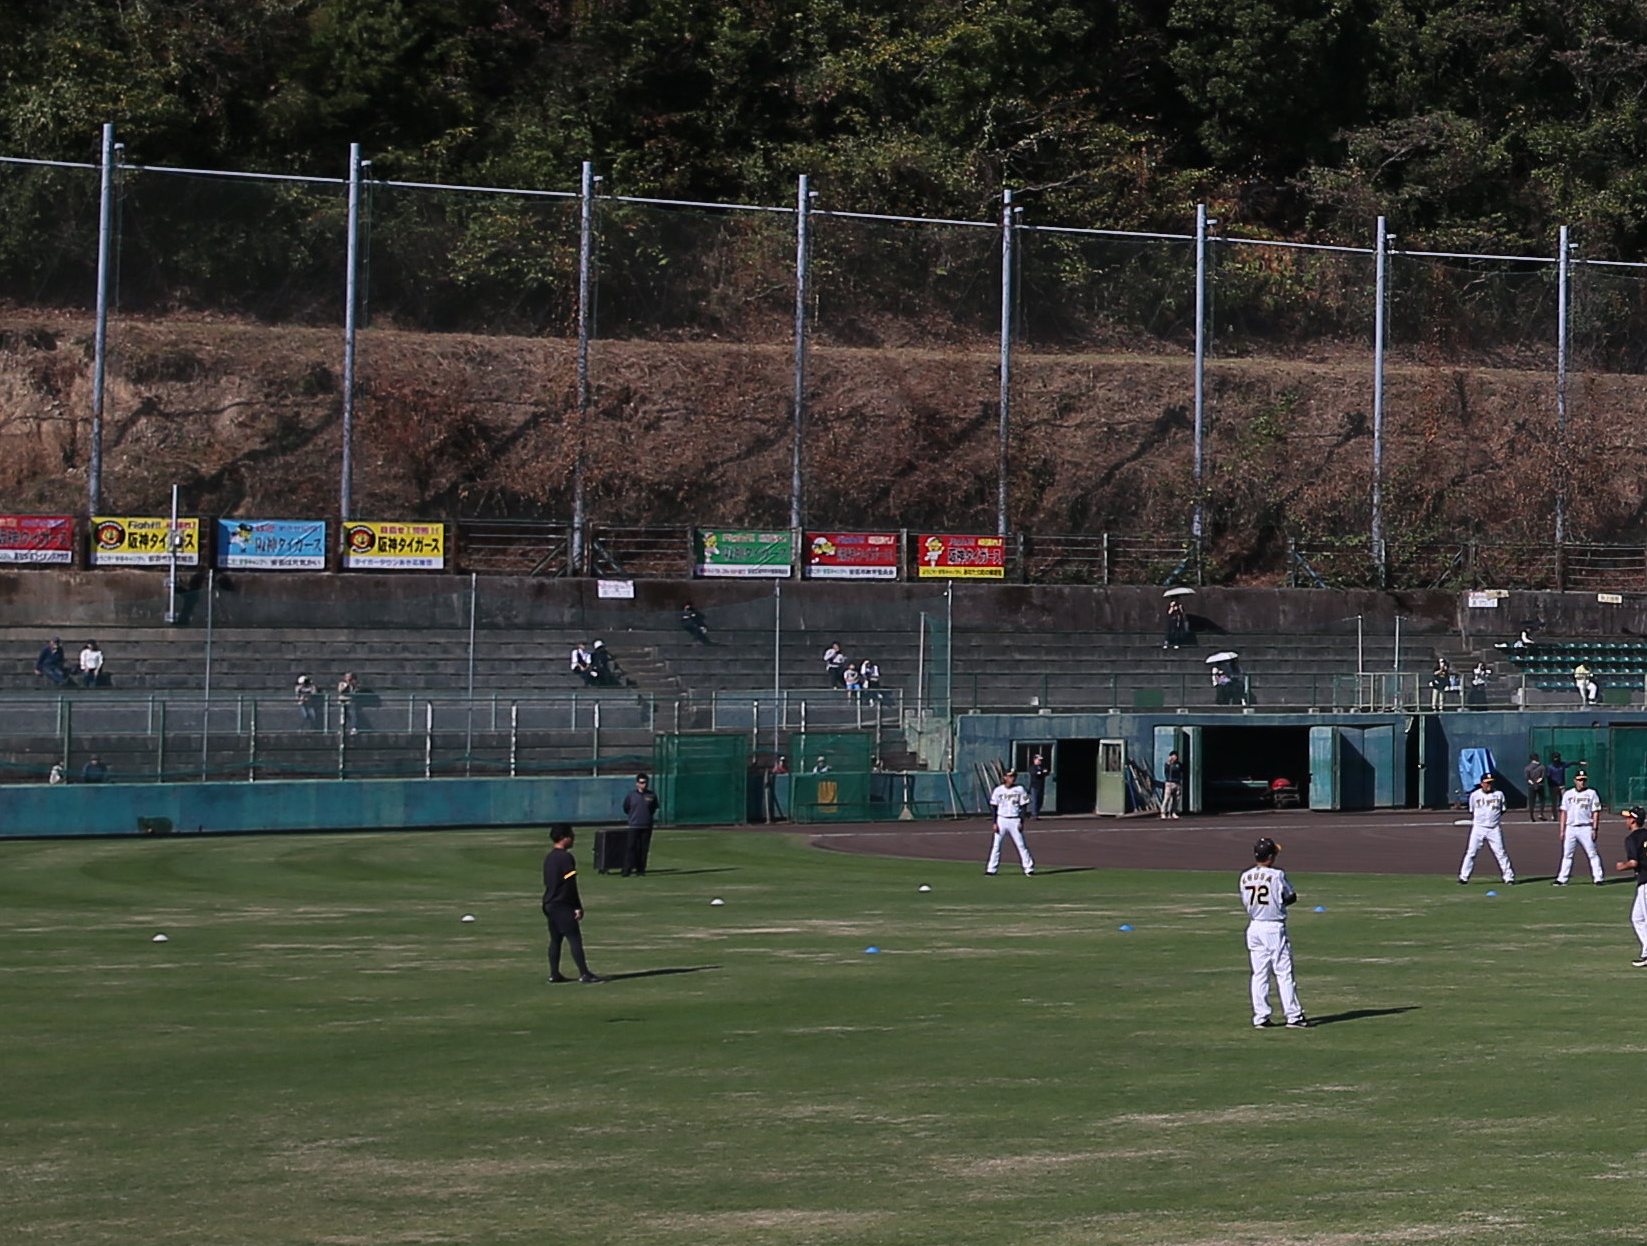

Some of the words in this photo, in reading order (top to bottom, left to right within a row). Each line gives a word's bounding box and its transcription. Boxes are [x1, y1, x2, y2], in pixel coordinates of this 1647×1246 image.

[378, 536, 440, 553] 阪神タイガース
[1245, 885, 1269, 906] 72
